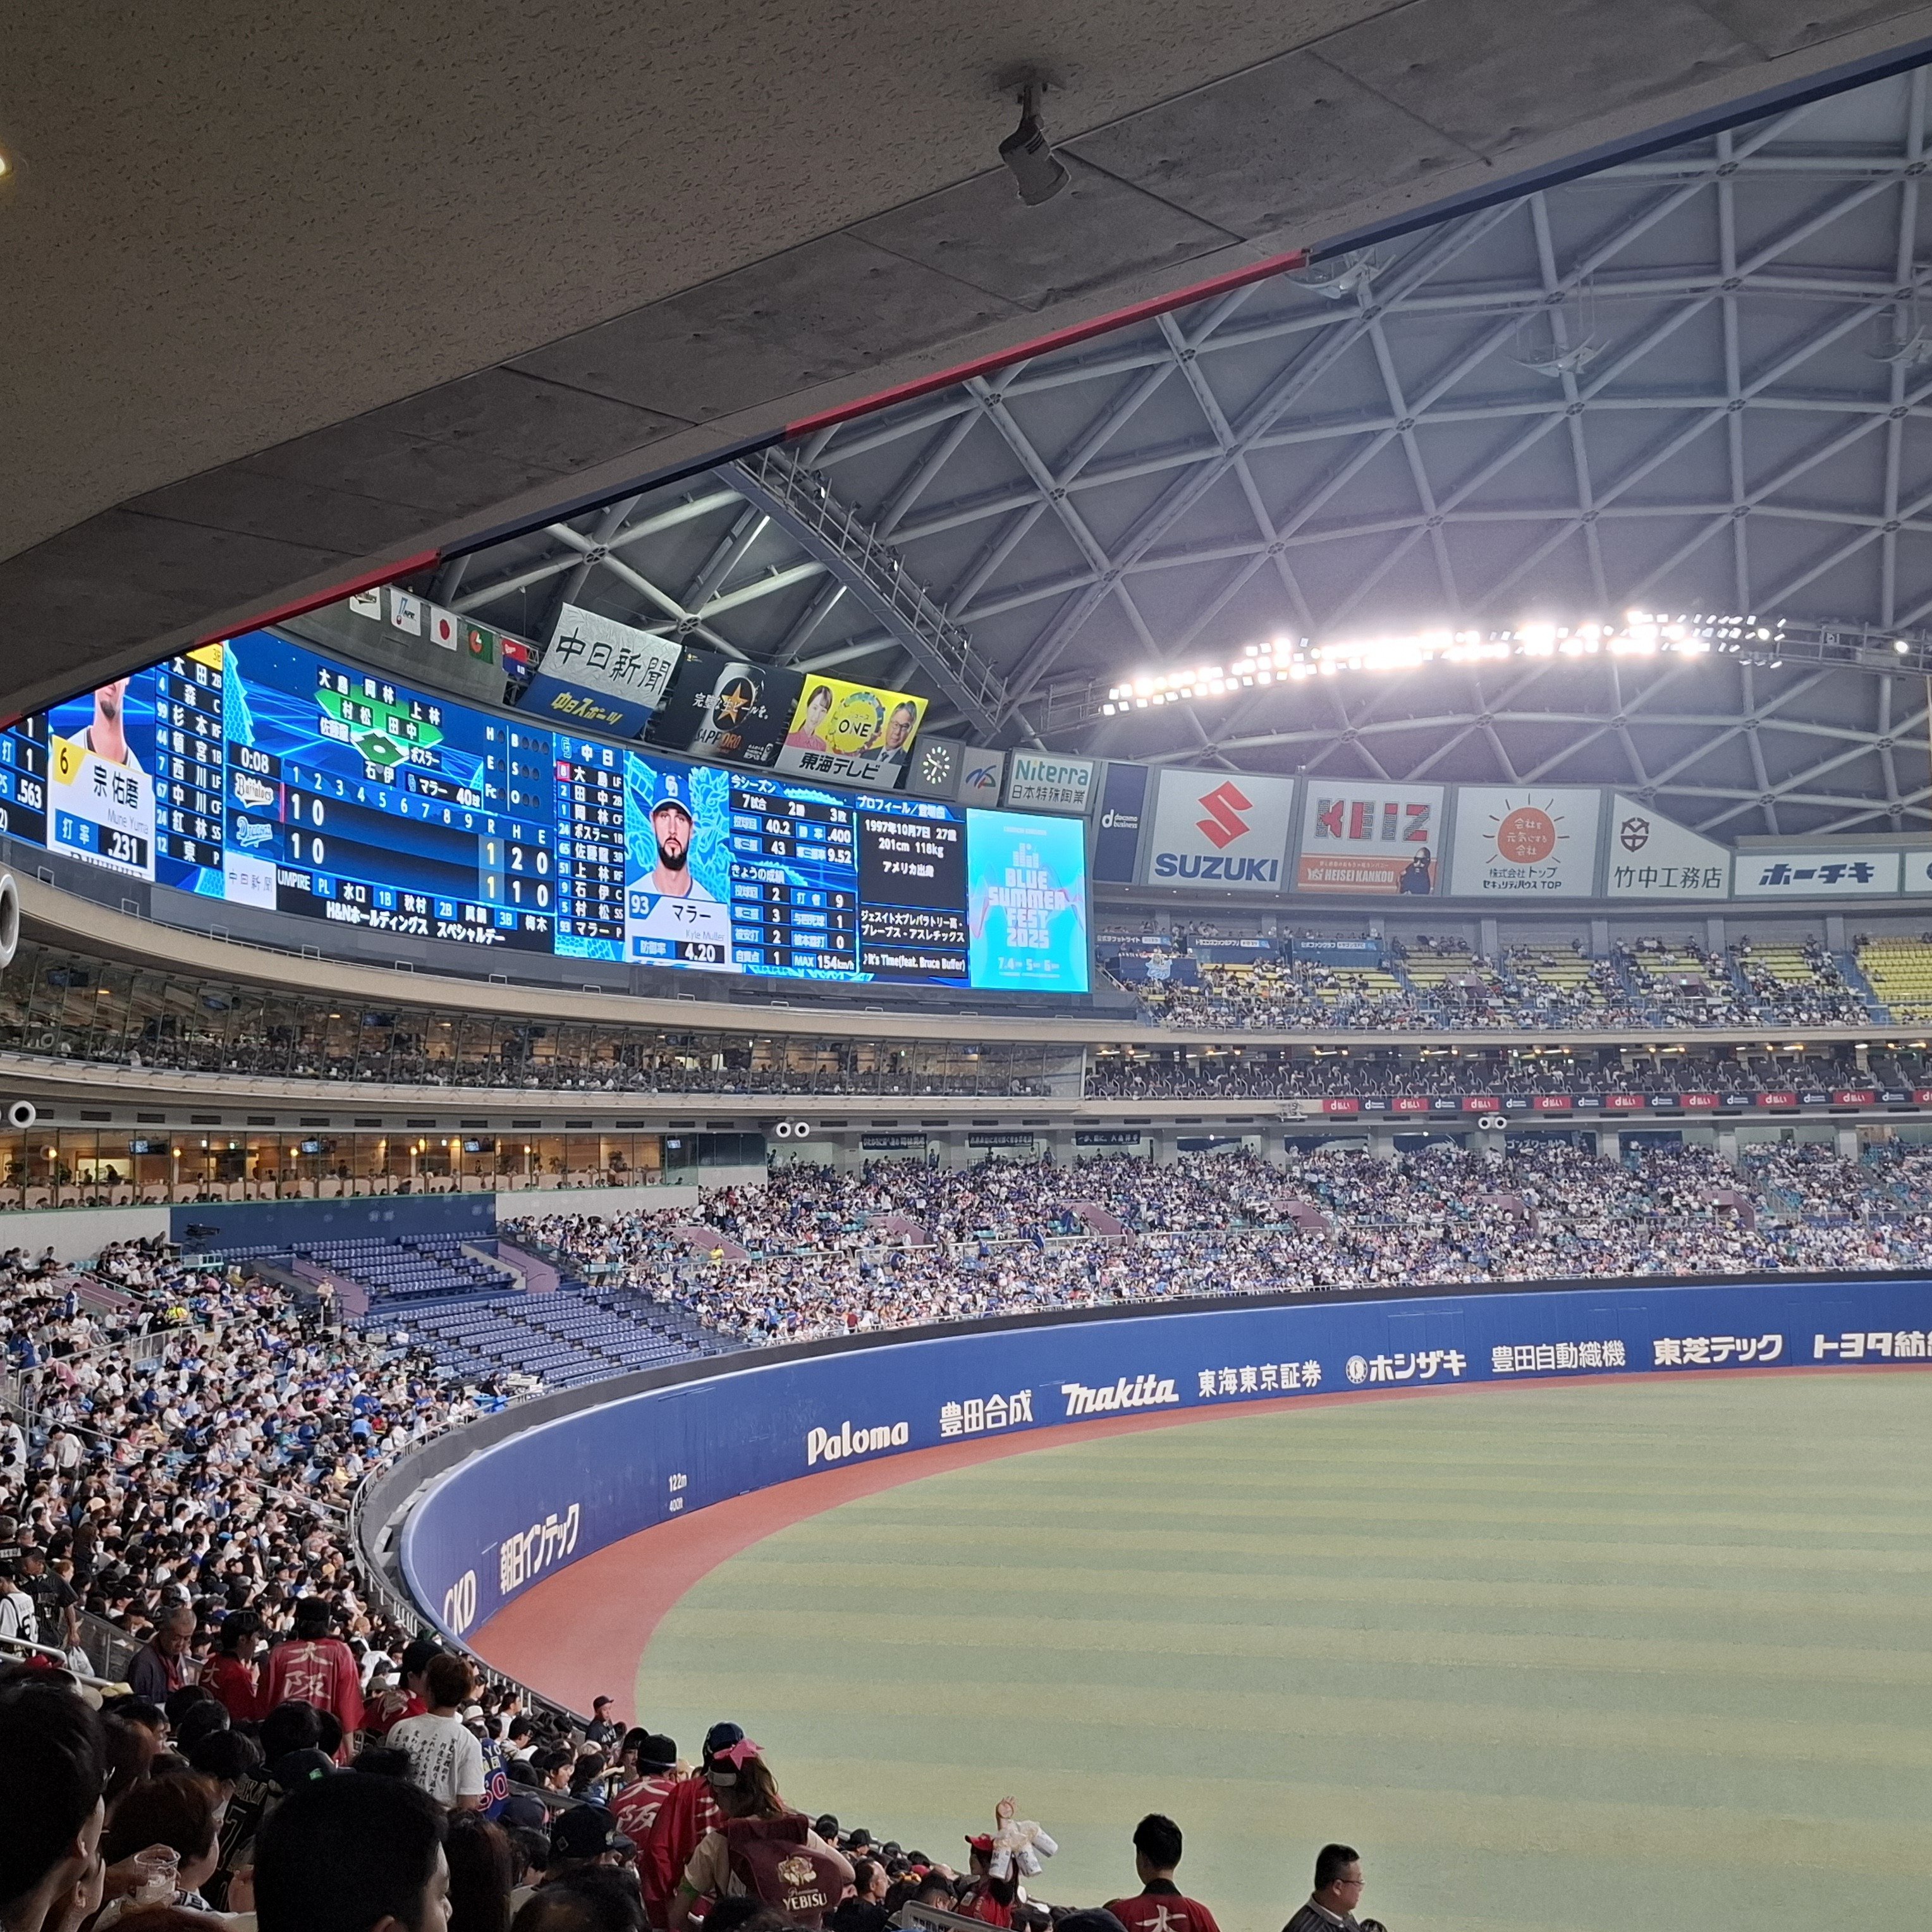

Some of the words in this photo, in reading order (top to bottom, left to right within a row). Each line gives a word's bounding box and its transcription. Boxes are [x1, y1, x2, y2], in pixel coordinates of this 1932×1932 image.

[556, 626, 673, 694] 中日新聞
[212, 673, 222, 688] 2B
[159, 677, 165, 692] 4
[184, 684, 196, 706] 森
[213, 699, 221, 713] C
[364, 678, 394, 704] 岡林
[410, 700, 440, 725] 上林
[157, 702, 168, 718] 99
[212, 724, 222, 738] RF
[341, 700, 372, 726] 村松
[388, 719, 417, 739] 田中
[549, 692, 624, 725] 中日スポーツ
[486, 726, 494, 741] H
[511, 733, 519, 747] B
[695, 728, 742, 750] SAPPORO
[838, 719, 872, 738] ONE
[157, 728, 168, 746] 44
[212, 749, 222, 764] 1B
[410, 747, 440, 765] ボスラー
[582, 744, 613, 767] 中日
[27, 749, 33, 771] 1
[60, 748, 68, 774] 6
[241, 747, 269, 774] 0:08
[487, 756, 494, 769] E
[511, 762, 519, 776] S
[798, 751, 881, 781] 東海テレビ
[158, 756, 164, 770] 7
[212, 774, 221, 789] LF
[365, 761, 394, 784] 石伊
[613, 777, 621, 787] LF
[731, 774, 776, 794] 今シーズン
[1015, 759, 1089, 786] Niterra
[18, 779, 42, 809] .563
[157, 783, 167, 798] 67
[211, 800, 222, 814] CF
[420, 779, 448, 796] マラー
[561, 785, 567, 797] 2
[575, 785, 608, 806] 田中
[1012, 785, 1085, 804] 日本特殊陶業
[293, 766, 298, 783] 1
[314, 773, 322, 790] 2
[336, 780, 344, 796] 3
[357, 787, 365, 802] 4
[379, 792, 386, 808] 5
[400, 798, 408, 813] 6
[422, 803, 429, 818] 7
[443, 809, 451, 824] 8
[465, 814, 472, 829] 9
[488, 819, 495, 835] R
[513, 824, 521, 840] H
[538, 829, 546, 844] E
[157, 809, 168, 826] 24
[211, 825, 221, 840] SS
[766, 819, 790, 835] 40.2
[828, 829, 851, 843] .400
[1315, 798, 1431, 842] KEIZ
[291, 793, 300, 819] 1
[313, 799, 324, 826] 0
[487, 842, 494, 864] 1
[512, 847, 522, 870] 2
[537, 852, 547, 874] 0
[559, 823, 570, 836] 24
[575, 824, 609, 841] ボスラー
[1507, 831, 1547, 843] 元気にする
[108, 832, 138, 863] .231
[157, 836, 167, 852] 12
[183, 840, 196, 863] 東
[214, 851, 219, 864] P
[771, 841, 785, 855] 43
[828, 848, 852, 864] 9.52
[879, 838, 909, 852] 201cm
[1516, 845, 1537, 856] 会社
[291, 833, 300, 859] 1
[313, 838, 324, 864] 0
[487, 876, 494, 898] 1
[513, 881, 520, 903] 1
[537, 884, 548, 907] 0
[559, 862, 569, 874] 51
[575, 863, 609, 882] 上林
[1005, 867, 1048, 888] BLUE
[1154, 853, 1278, 882] SUZUKI
[1613, 866, 1722, 889] 竹中工務店
[1759, 862, 1875, 886] ホーチキ
[561, 882, 568, 893] 9
[616, 889, 622, 901] C
[1541, 880, 1562, 890] TOP
[278, 869, 311, 891] UMPIRE
[318, 879, 330, 895] PL
[343, 883, 365, 903] 水口
[380, 891, 392, 907] 1B
[439, 902, 452, 917] 2B
[499, 912, 512, 927] 3B
[632, 895, 649, 913] 93
[772, 888, 780, 901] 2
[836, 895, 843, 908] 9
[987, 887, 1065, 910] SUMMER
[561, 901, 568, 913] 5
[575, 901, 609, 919] 村松
[671, 905, 711, 923] マラー
[773, 908, 780, 922] 3
[837, 915, 843, 928] 1
[1006, 908, 1049, 929] FEST
[326, 901, 429, 936] H&Nホールディングス
[437, 922, 506, 945] スペシャルデー
[559, 921, 570, 933] 93
[576, 922, 610, 936] マラー
[685, 929, 700, 940] Kyle
[773, 931, 781, 944] 2
[836, 936, 844, 949] 0
[1006, 927, 1049, 949] 2025
[685, 945, 716, 962] 4.20
[774, 951, 780, 965] 1
[795, 956, 814, 967] MAX
[1492, 1340, 1625, 1373] 豊田自動織機
[1653, 1334, 1782, 1366] 東芝テック
[1369, 1350, 1466, 1381] ホシザキ
[1199, 1360, 1321, 1397] 東海東京証券
[1061, 1373, 1179, 1415] Makita
[939, 1389, 1034, 1438] 豊田合成
[808, 1421, 908, 1466] Paloma
[669, 1473, 687, 1492] 122m
[500, 1503, 580, 1594] 朝日インテック
[444, 1570, 475, 1636] CKD
[783, 1893, 828, 1911] YEBISU
